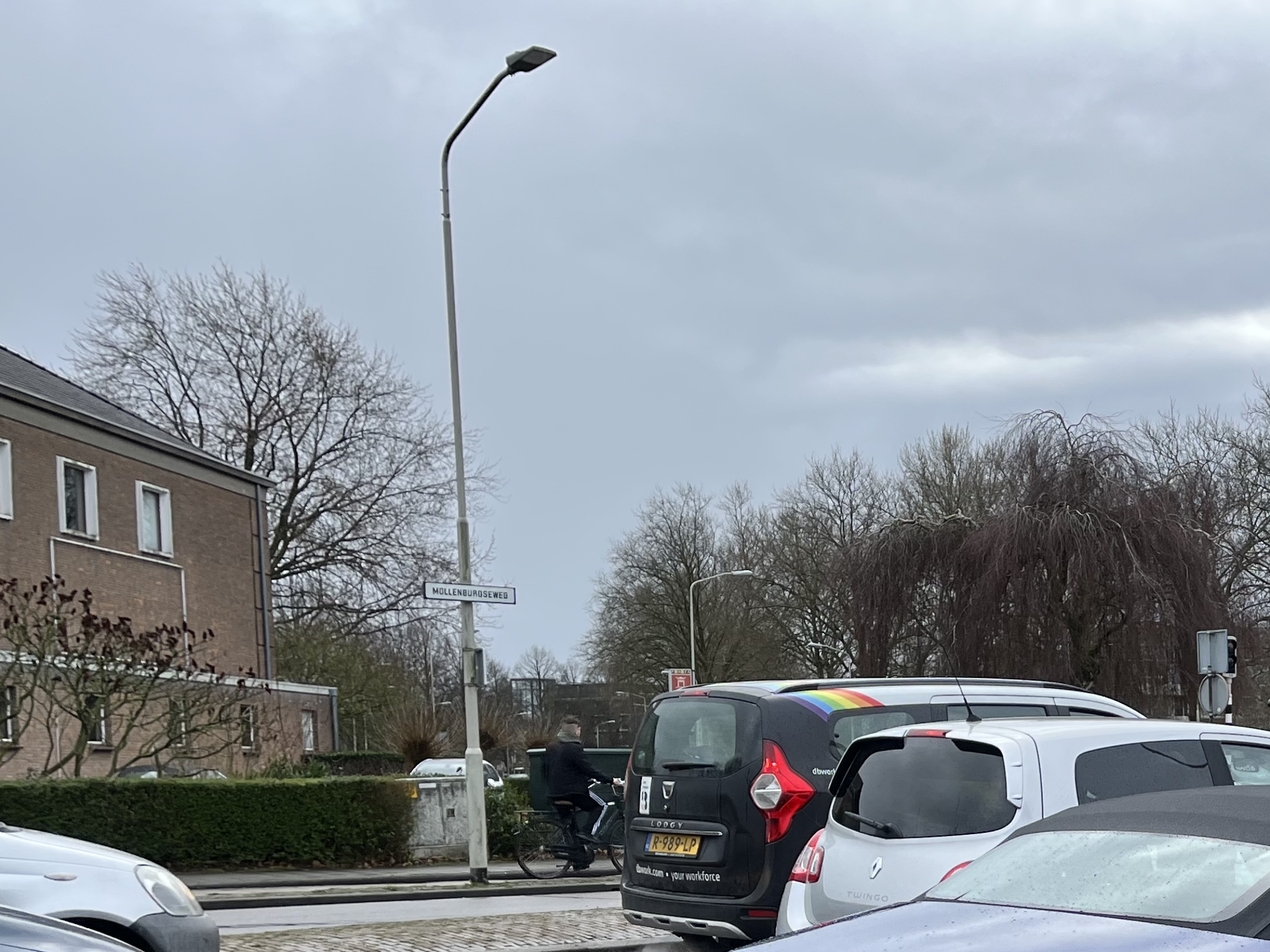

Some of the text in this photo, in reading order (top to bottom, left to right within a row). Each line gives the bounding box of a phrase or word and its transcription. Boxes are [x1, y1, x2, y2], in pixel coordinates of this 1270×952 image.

[650, 820, 684, 829] LODGY
[652, 835, 697, 853] R-989-LP
[670, 871, 685, 882] your
[685, 870, 721, 882] workforce
[846, 890, 889, 902] TWINGO
